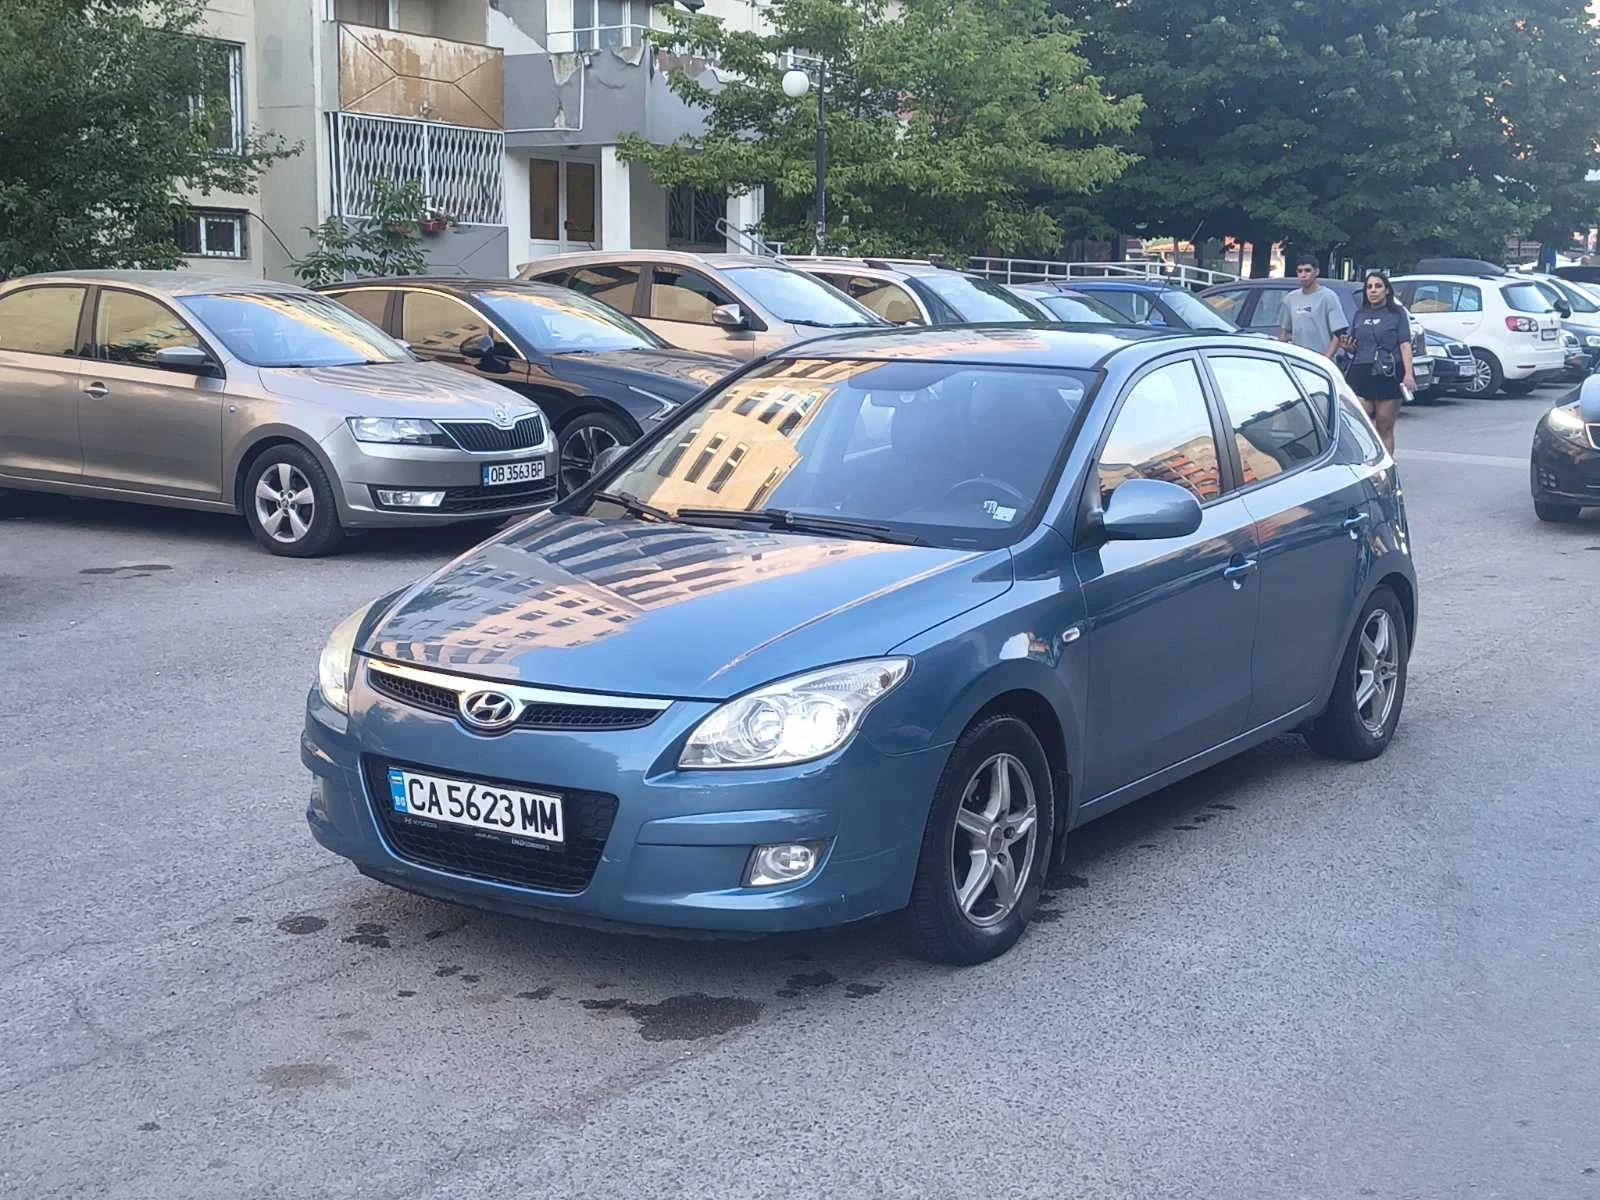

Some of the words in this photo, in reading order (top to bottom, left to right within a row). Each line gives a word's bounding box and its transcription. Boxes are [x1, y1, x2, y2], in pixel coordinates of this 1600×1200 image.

[506, 464, 530, 481] 3563
[409, 778, 443, 815] CA
[447, 785, 515, 827] 5623
[520, 797, 558, 836] MM
